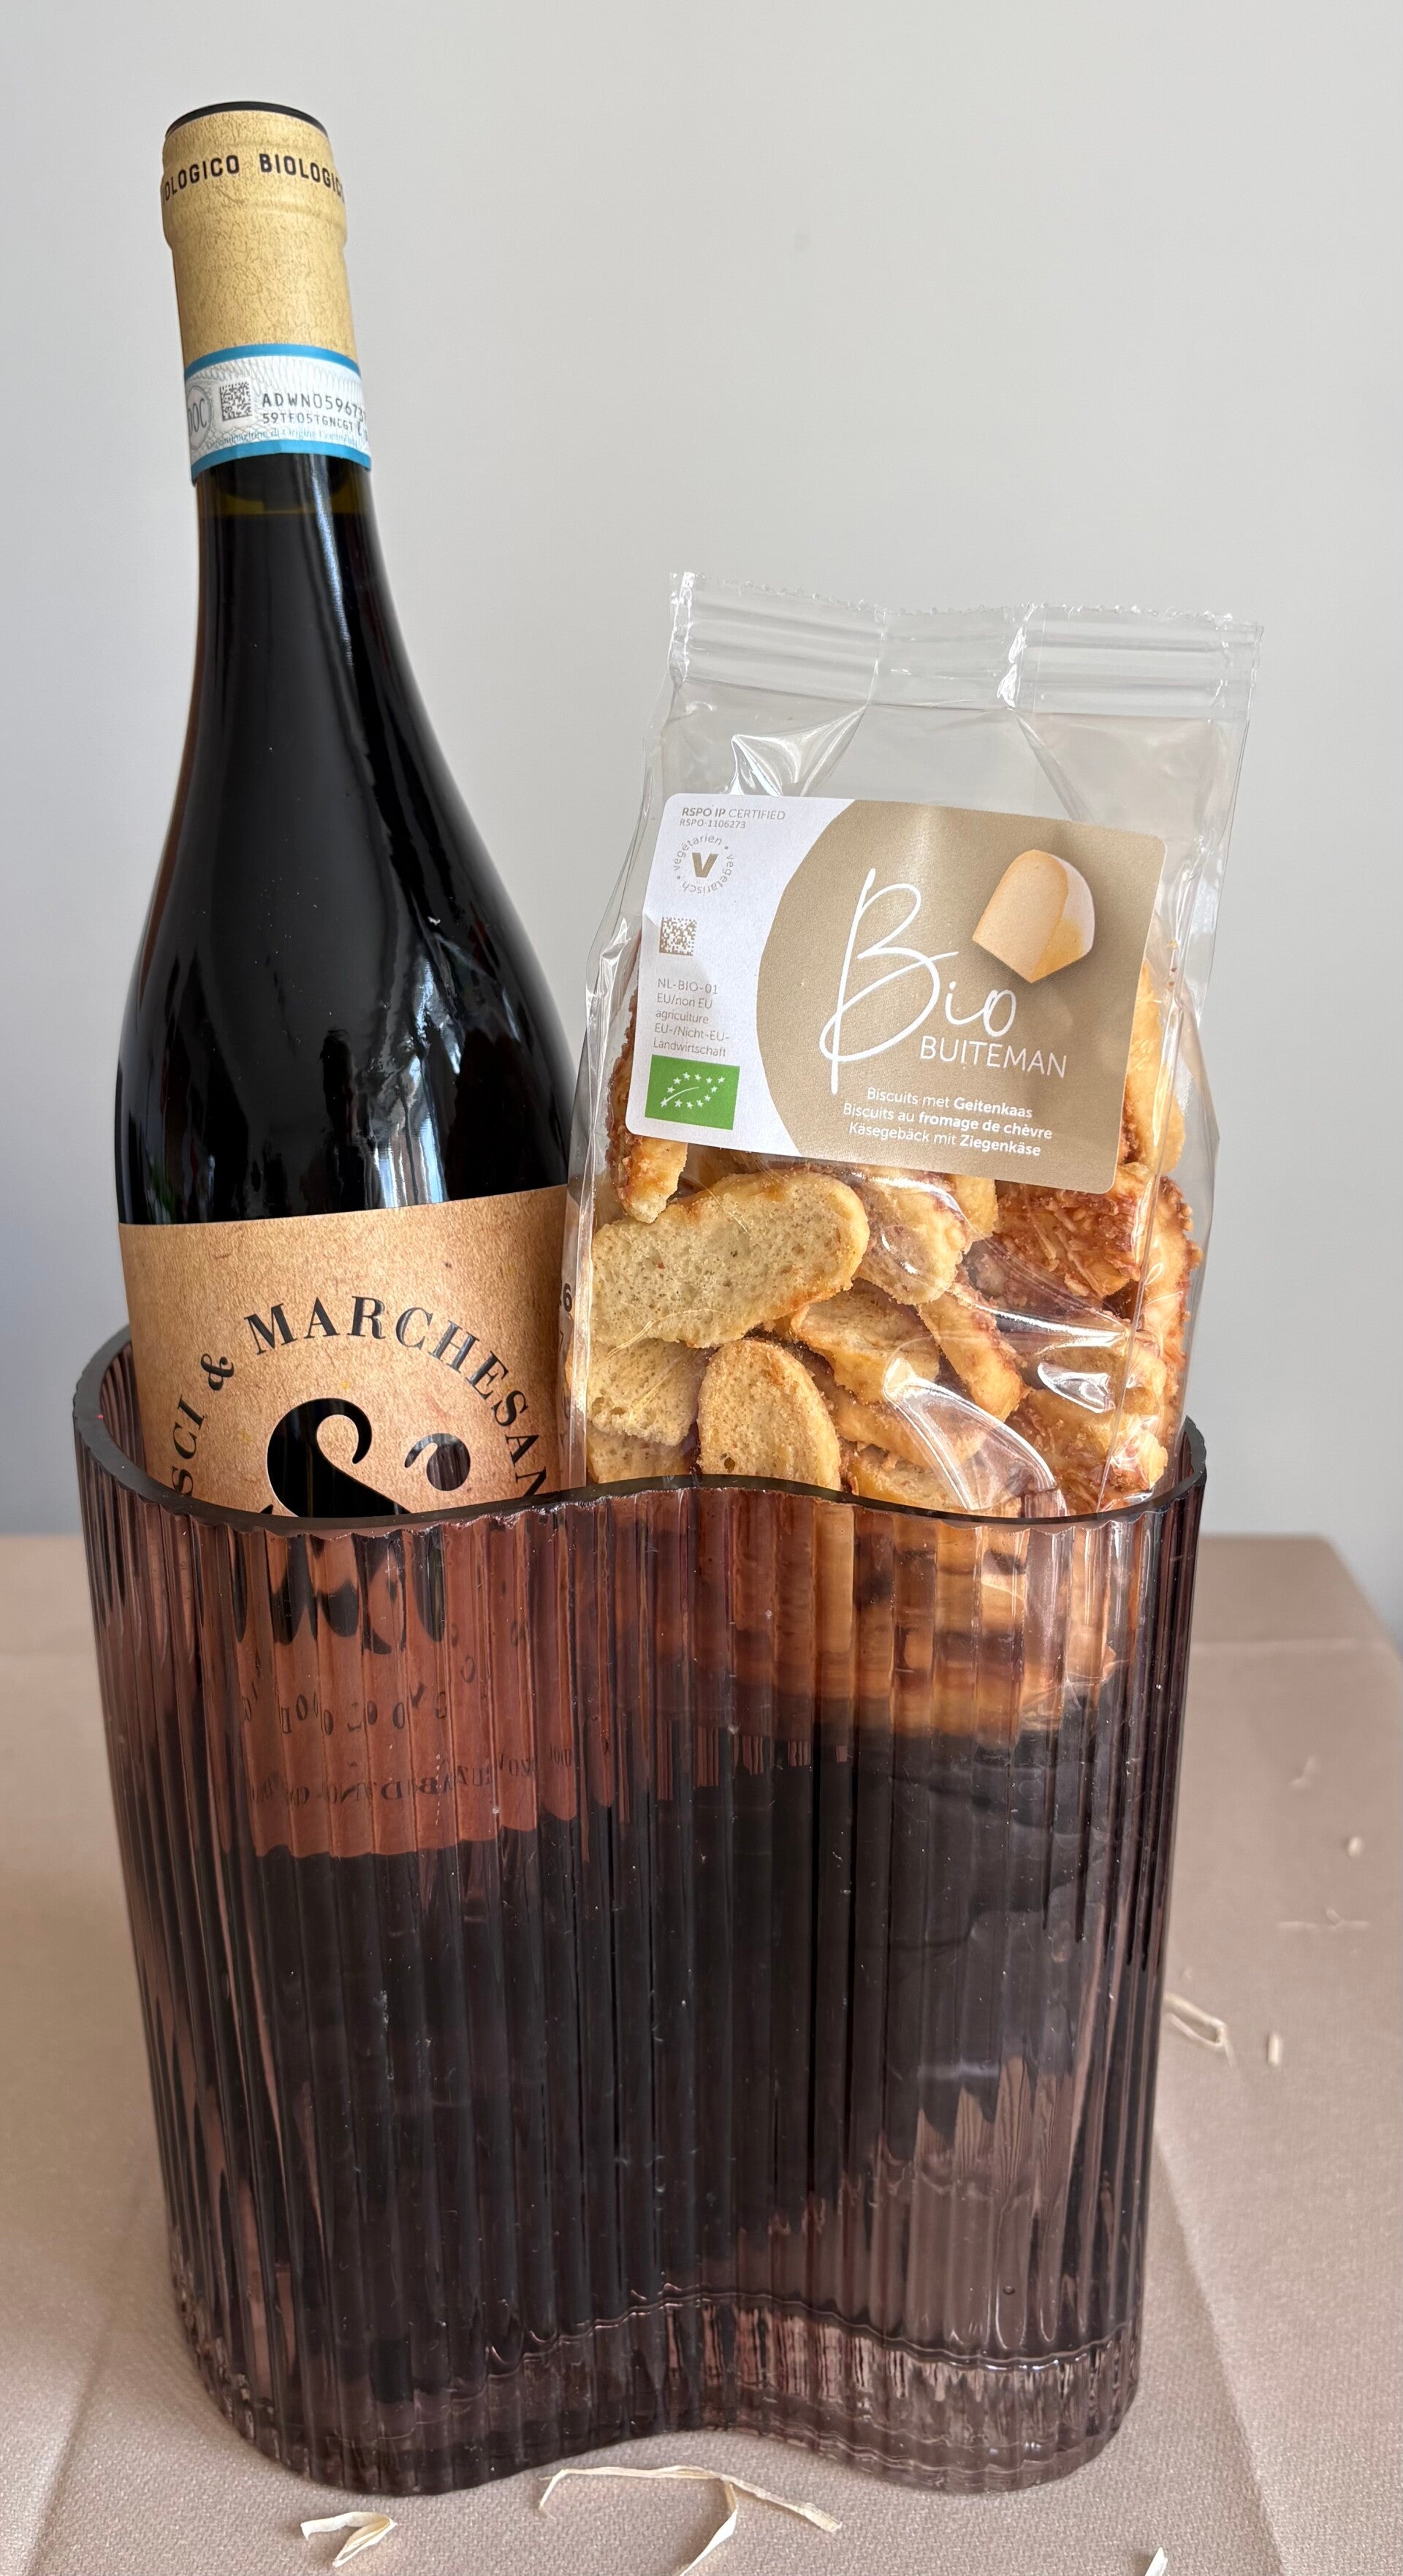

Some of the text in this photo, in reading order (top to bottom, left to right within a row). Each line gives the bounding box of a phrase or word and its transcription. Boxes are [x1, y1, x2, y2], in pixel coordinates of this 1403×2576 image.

[259, 153, 345, 204] BIOLOGIC
[680, 818, 746, 829] RSPO-1106273
[682, 807, 786, 820] RSPO IP CERTIFIED
[682, 853, 734, 896] vegetarisch
[658, 978, 718, 995] NL-BIO-01
[819, 867, 1016, 1095] Bio
[655, 1009, 710, 1024] agriculture
[657, 992, 713, 1009] EU/non EU
[653, 1037, 726, 1057] Landwirtschaft
[655, 1022, 730, 1042] EU-/Nicht-EU-
[919, 1034, 1068, 1078] BUITEMAN
[867, 1086, 1033, 1118] Biscuits met Geitenkaas
[843, 1102, 1053, 1140] Biscuits au fromage de chèvre
[848, 1121, 1041, 1156] Käsegebäck mit Ziegenkäse
[200, 1353, 235, 1391] &
